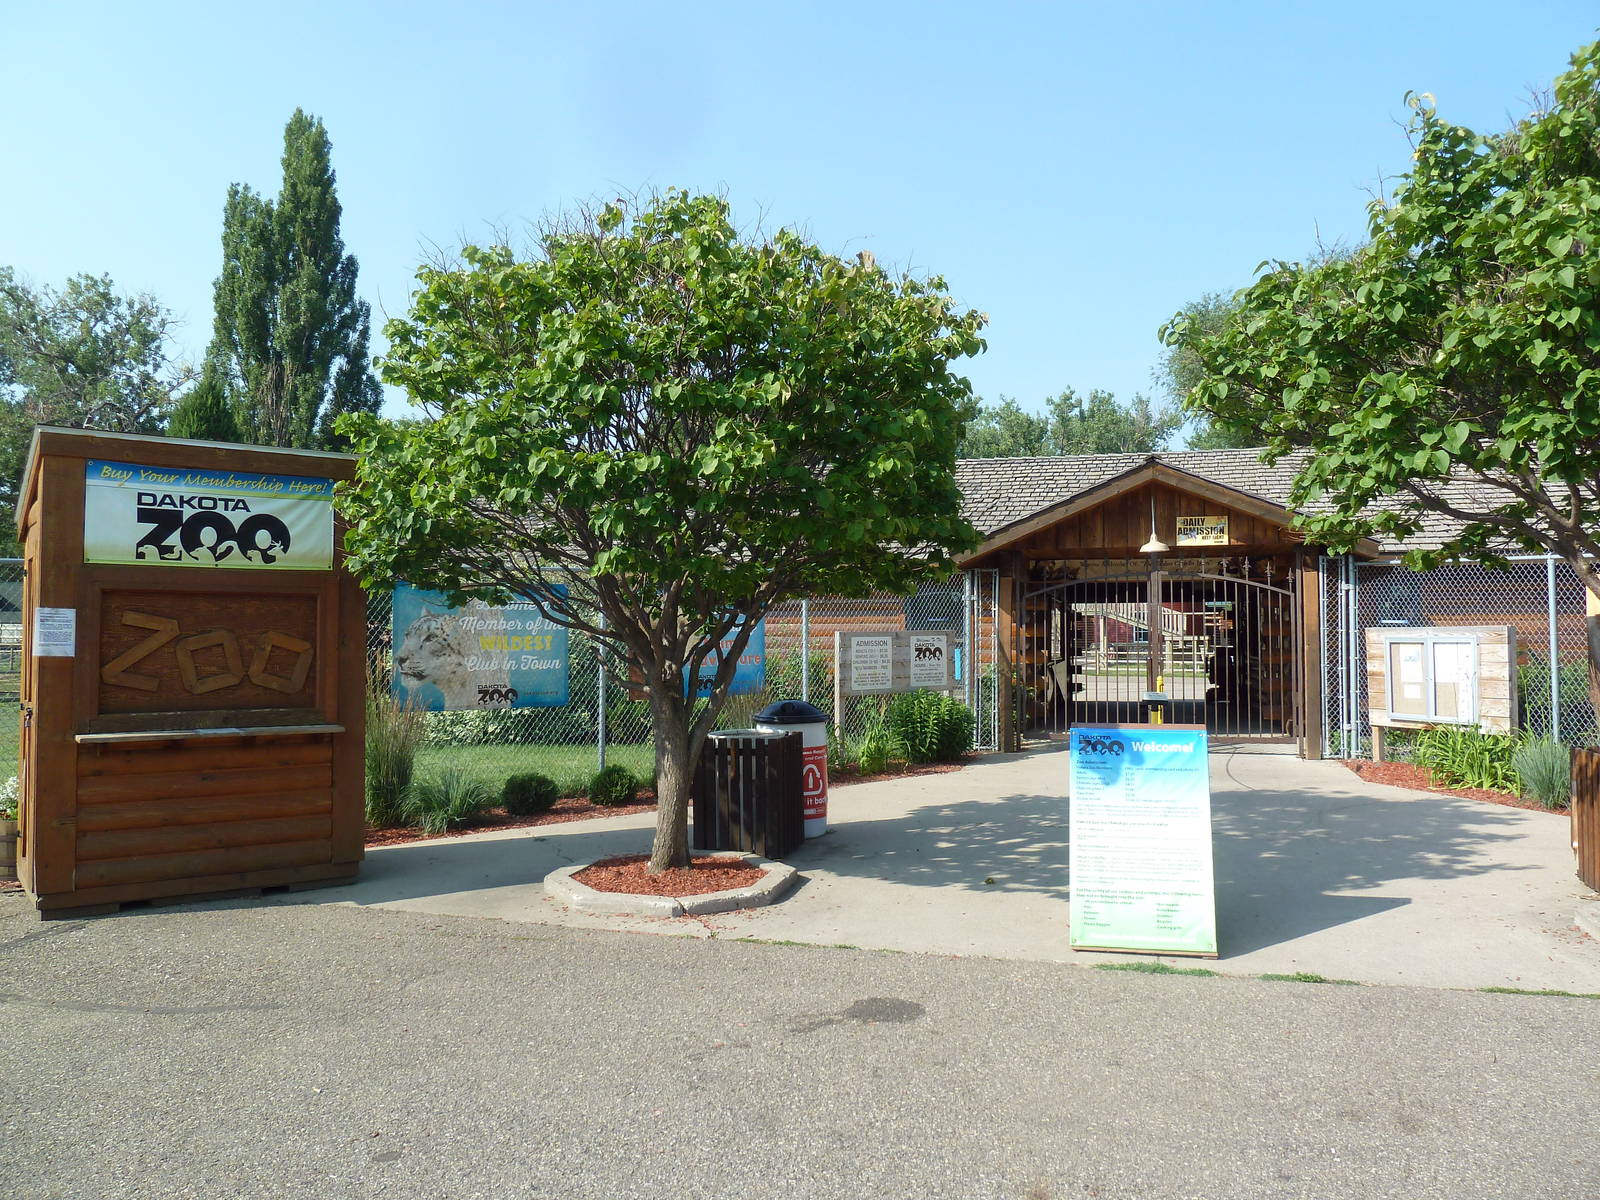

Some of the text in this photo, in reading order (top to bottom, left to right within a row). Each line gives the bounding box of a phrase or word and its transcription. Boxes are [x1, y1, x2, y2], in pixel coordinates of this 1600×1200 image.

[100, 465, 328, 497] Buy Your Membership Here!
[137, 492, 251, 513] DAKOTA
[1183, 517, 1205, 526] DAILY
[136, 507, 291, 564] ZOO
[1177, 526, 1225, 536] ADMISSION
[459, 616, 524, 634] Member
[525, 616, 543, 635] of
[480, 635, 554, 651] WILDEST
[914, 647, 943, 661] ZOO
[464, 655, 562, 671] Club in Town
[477, 688, 519, 705] ZOO
[1078, 739, 1195, 756] ZOO Welcome!
